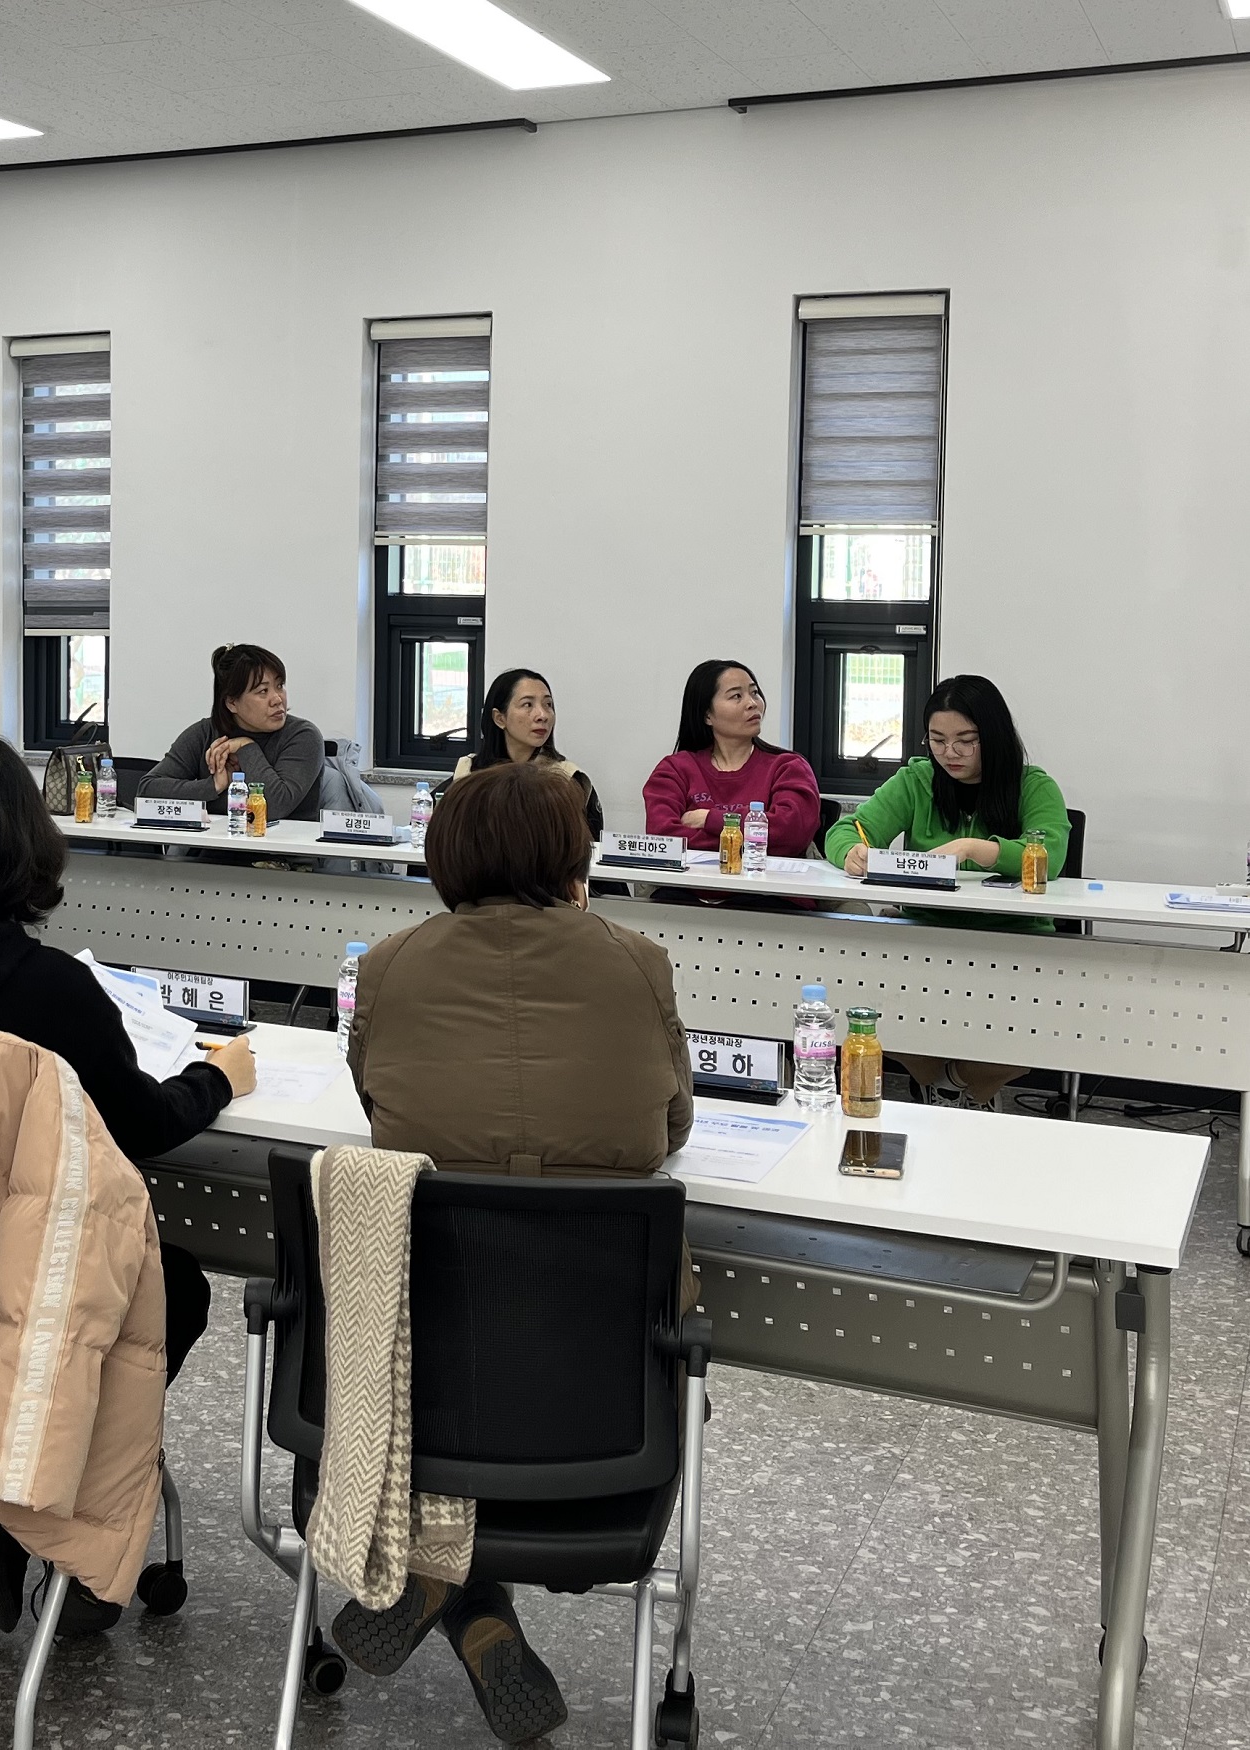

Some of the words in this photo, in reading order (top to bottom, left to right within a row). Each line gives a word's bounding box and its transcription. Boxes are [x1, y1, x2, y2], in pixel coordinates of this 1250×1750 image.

[158, 805, 181, 815] 장주현
[345, 818, 371, 829] 김경민
[896, 858, 929, 871] 남유하
[167, 972, 214, 986] 이주민지원팀장
